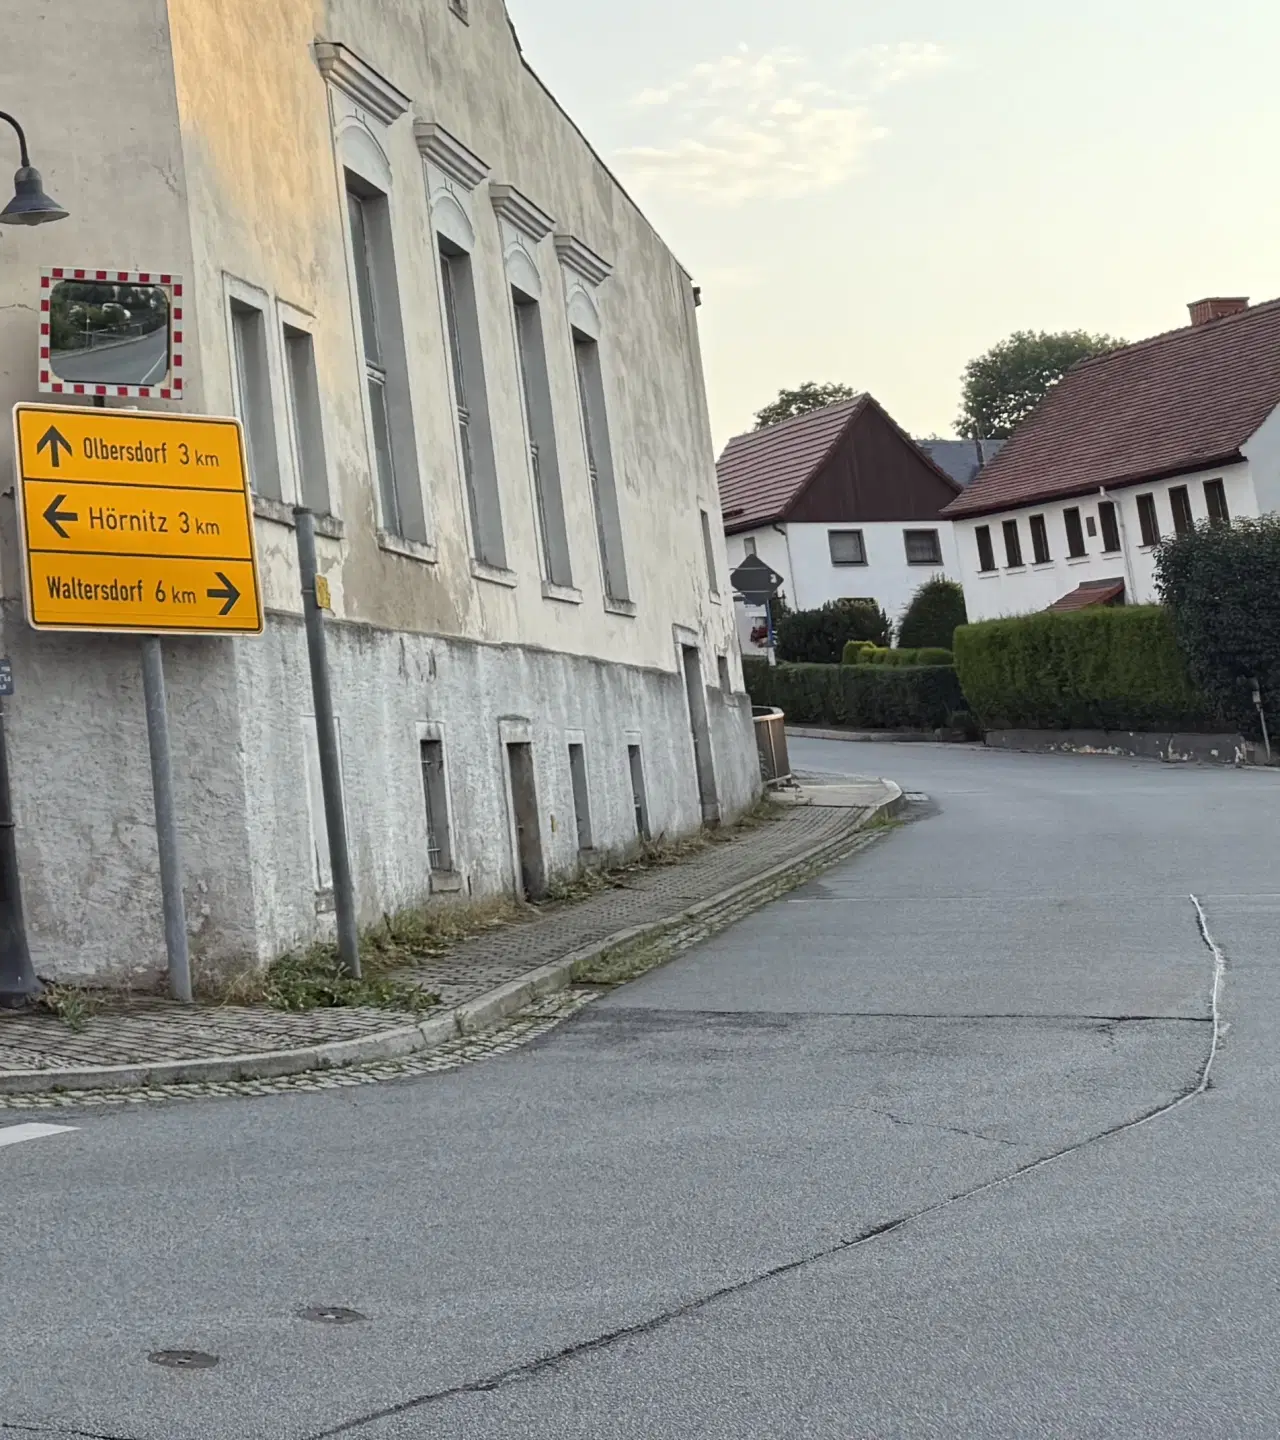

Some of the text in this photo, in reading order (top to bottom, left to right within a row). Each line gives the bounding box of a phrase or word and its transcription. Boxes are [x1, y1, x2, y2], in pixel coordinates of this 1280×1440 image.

[83, 437, 219, 467] Olbersdorf 3 km
[89, 506, 220, 536] Hörnitz 3 km
[47, 575, 197, 604] Waltersdorf 6 km
